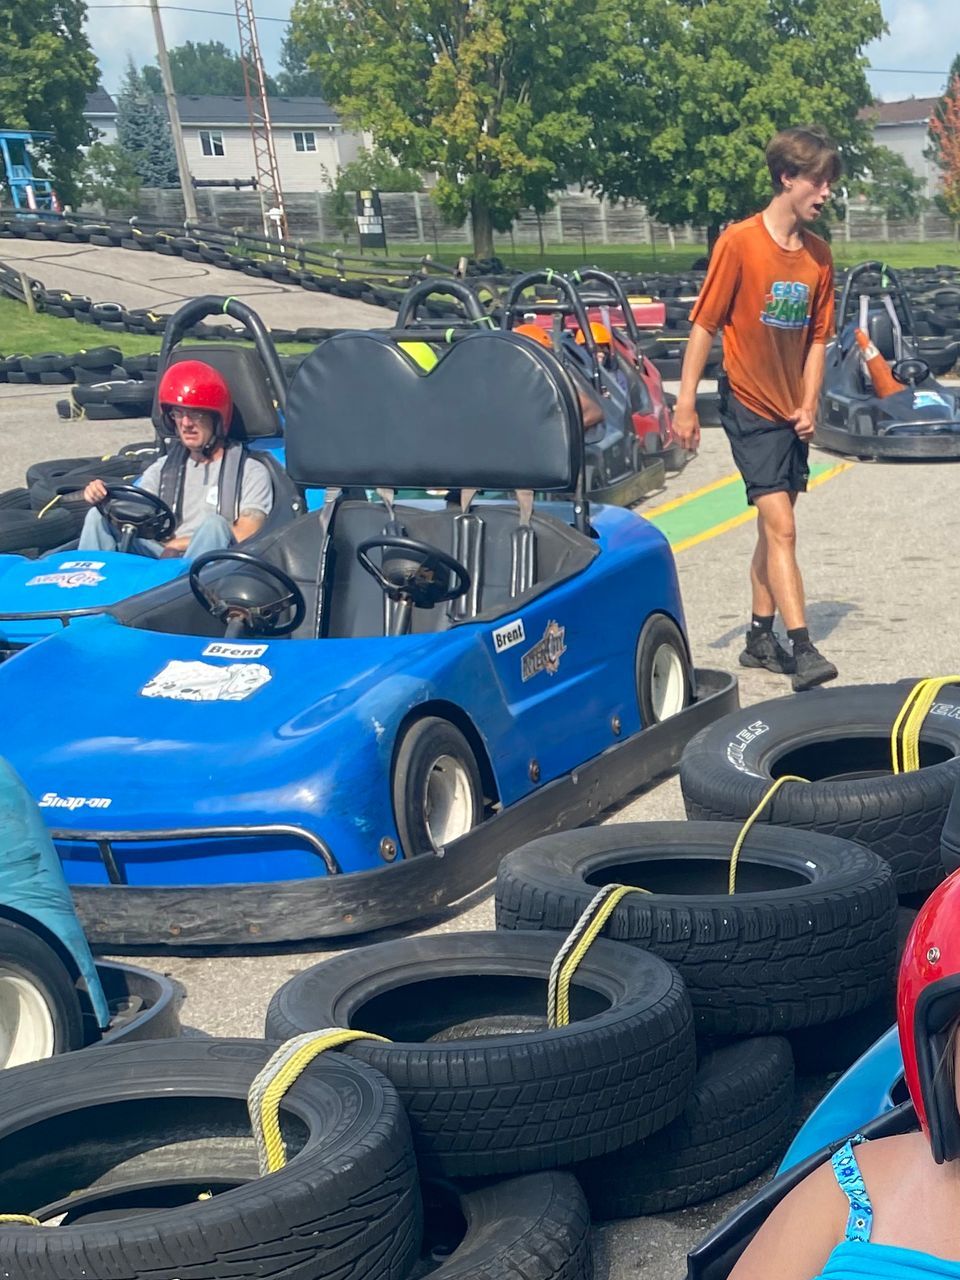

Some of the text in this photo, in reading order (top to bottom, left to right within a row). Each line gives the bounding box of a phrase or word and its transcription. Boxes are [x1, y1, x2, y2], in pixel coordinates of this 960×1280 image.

[495, 624, 523, 648] Brent
[208, 645, 263, 656] Brent
[38, 792, 113, 811] Snap-on
